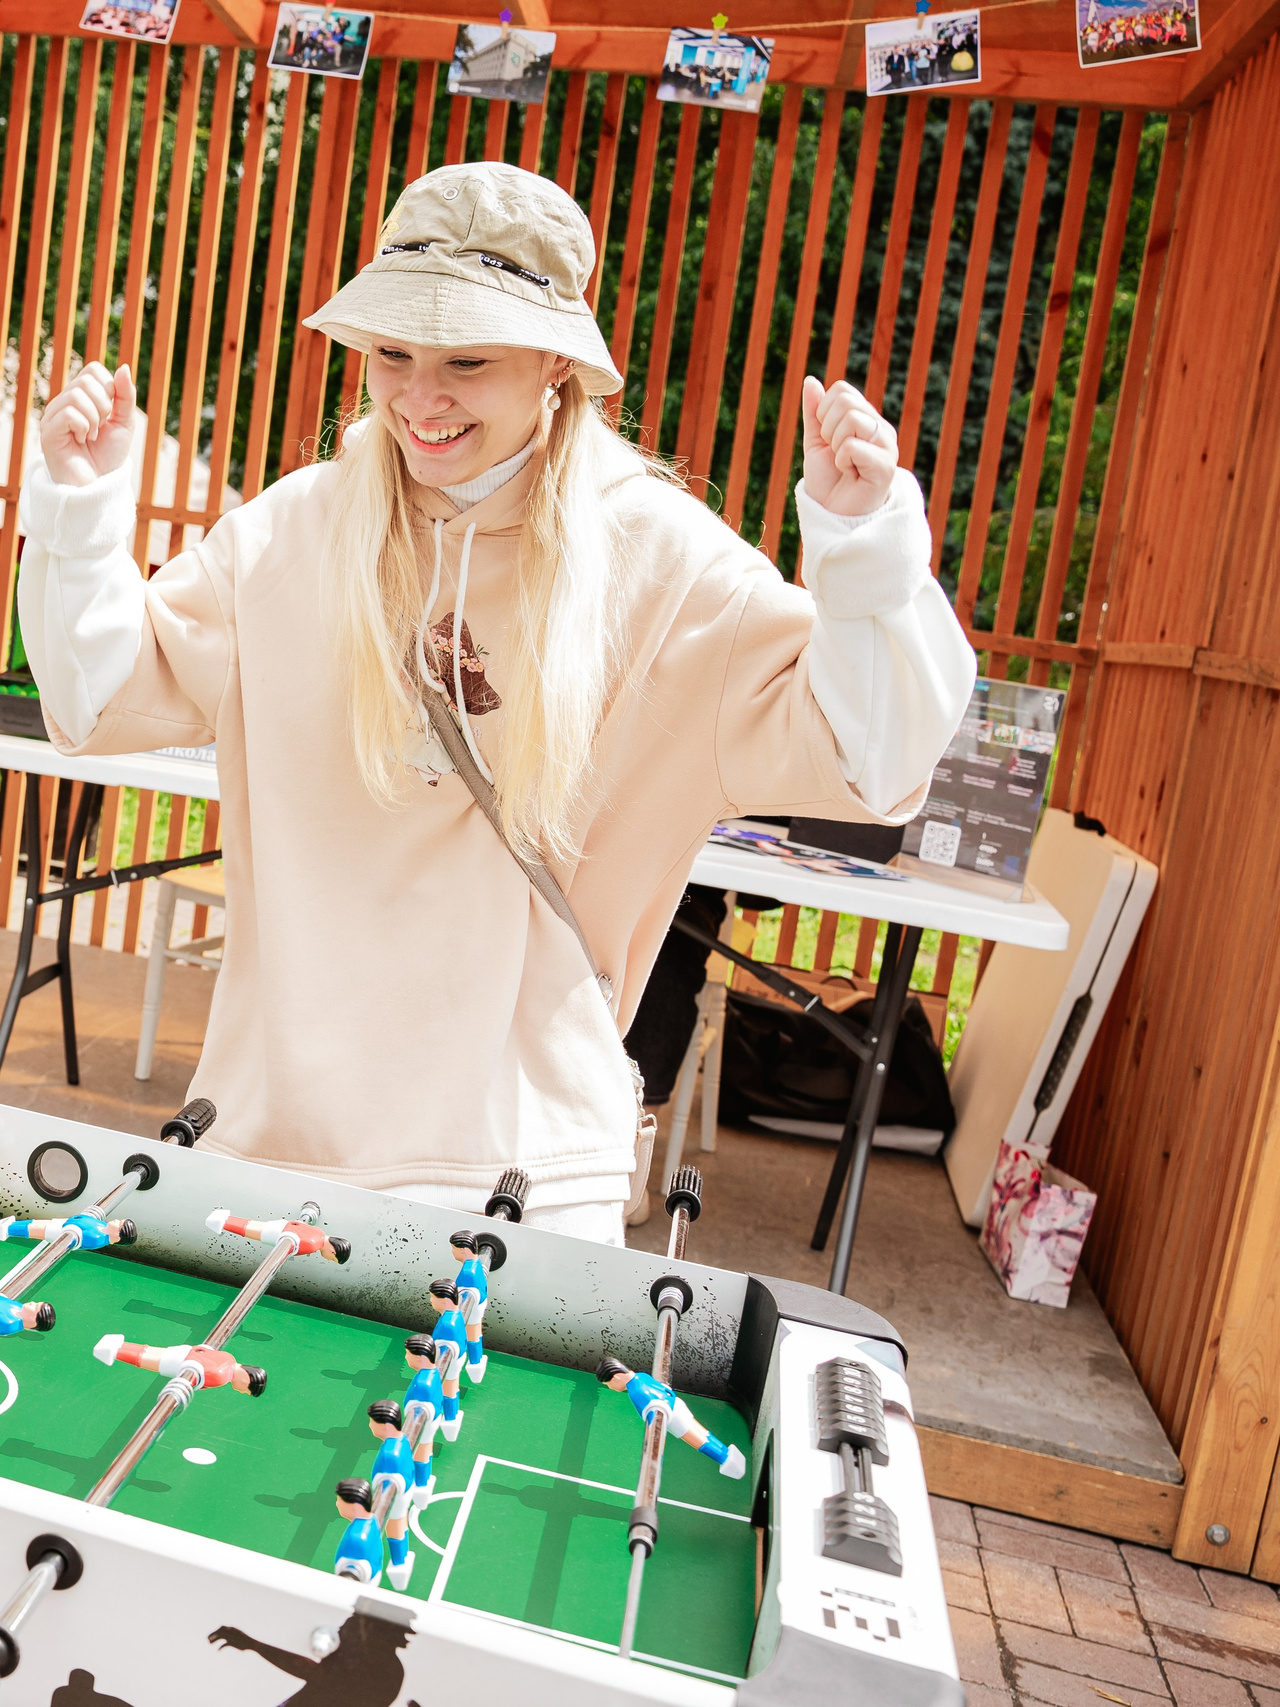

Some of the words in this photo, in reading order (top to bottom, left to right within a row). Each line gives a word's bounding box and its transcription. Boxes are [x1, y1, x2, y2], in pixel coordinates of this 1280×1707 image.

[843, 1386, 863, 1394] 8
[844, 1394, 864, 1403] 7
[846, 1414, 866, 1424] 5
[853, 1503, 876, 1516] 2
[855, 1517, 877, 1527] 1
